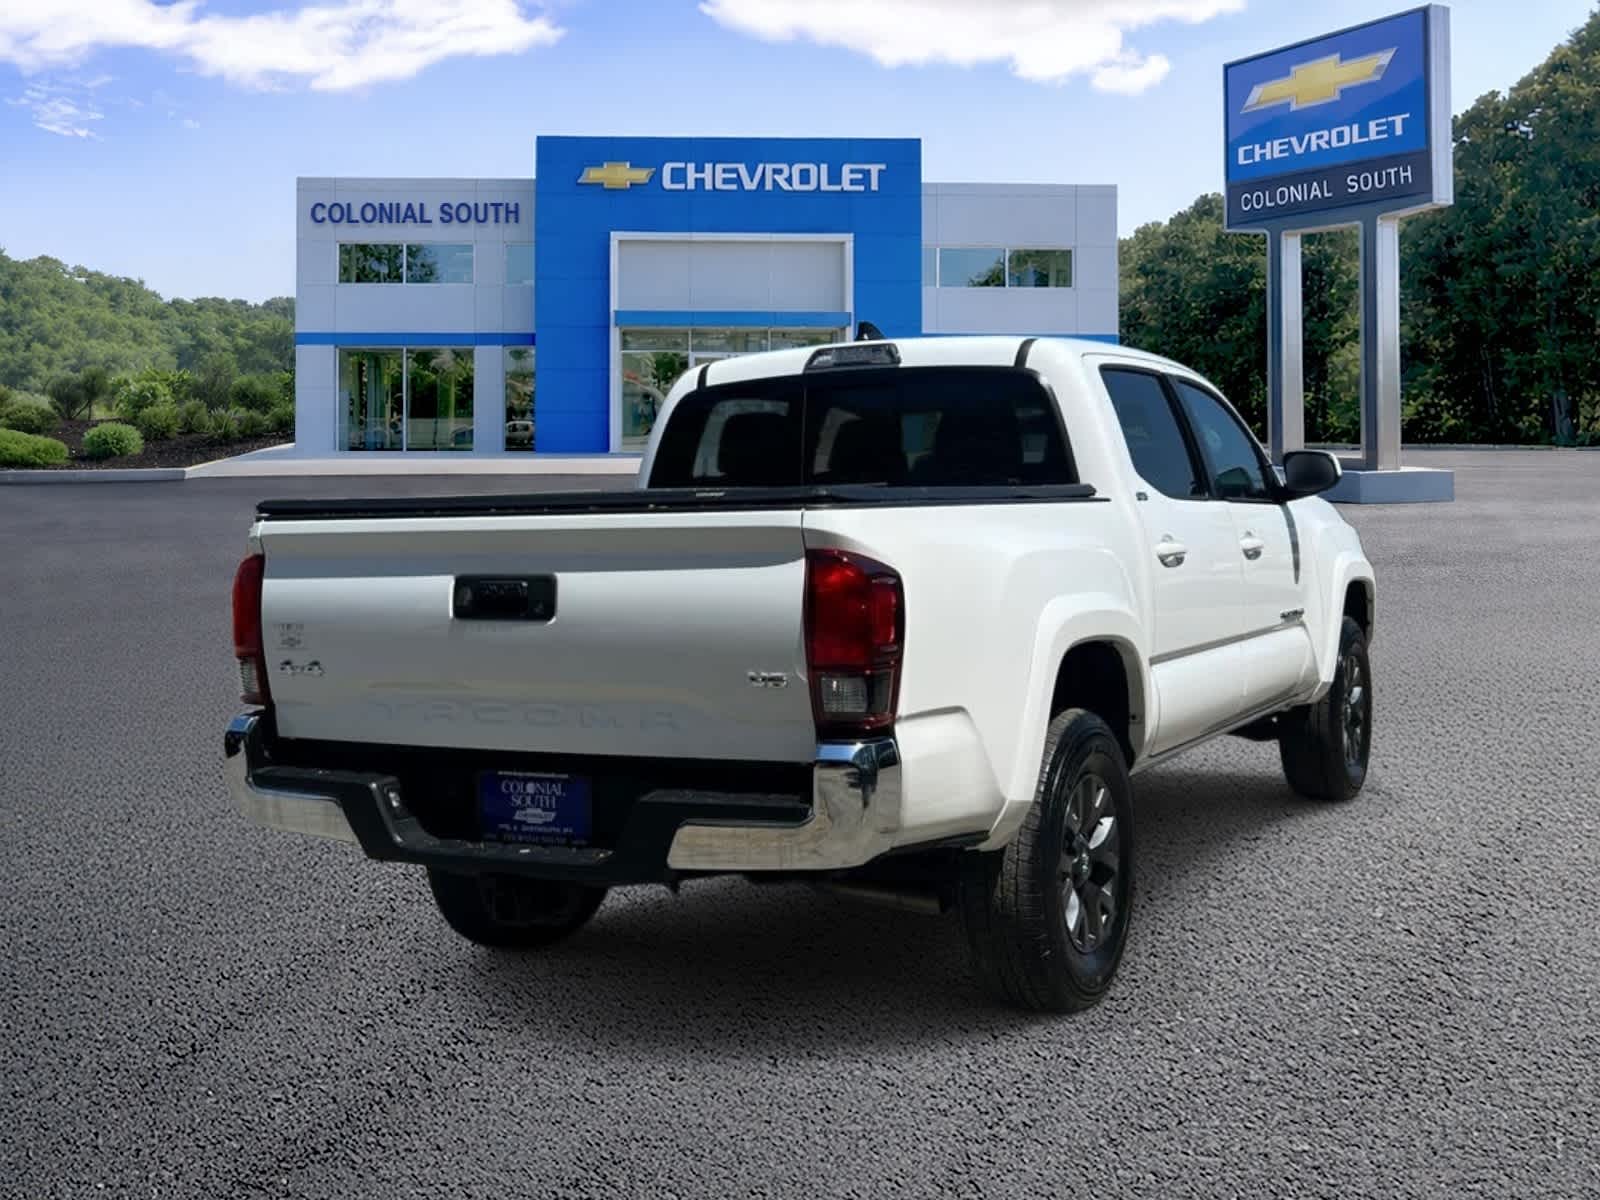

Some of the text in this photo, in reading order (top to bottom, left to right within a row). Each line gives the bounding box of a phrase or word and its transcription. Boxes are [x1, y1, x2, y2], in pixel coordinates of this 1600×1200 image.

[1237, 113, 1410, 166] CHEVROLET
[661, 161, 887, 193] CHEVROLET
[1240, 165, 1413, 212] COLONIAL SOUTH
[310, 202, 521, 225] COLONIAL SOUTH
[369, 700, 681, 734] TACOMA
[501, 780, 566, 797] COLONIAL
[511, 794, 557, 809] SOUTH
